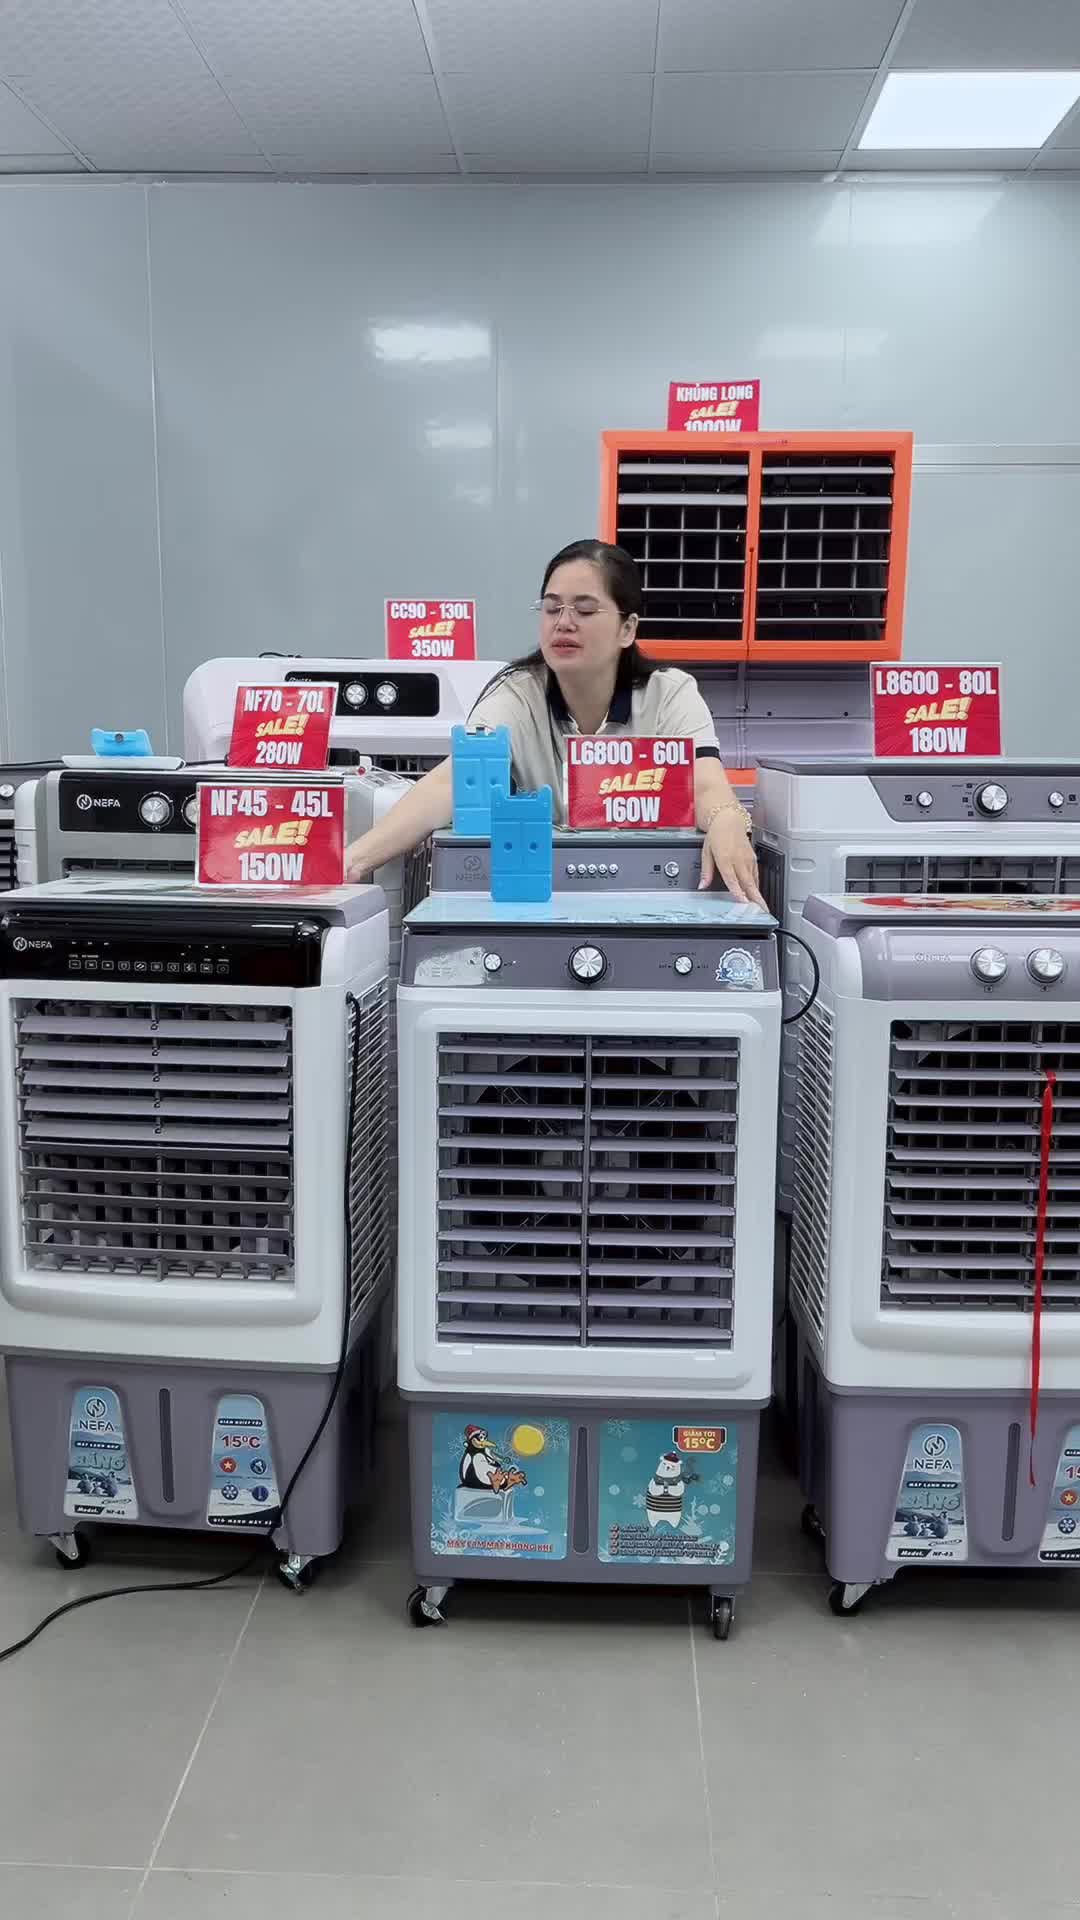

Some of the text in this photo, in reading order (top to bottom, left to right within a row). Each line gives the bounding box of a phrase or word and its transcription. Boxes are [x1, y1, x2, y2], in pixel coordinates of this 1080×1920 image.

[721, 384, 753, 400] LONG
[689, 401, 739, 420] SALE!
[391, 603, 426, 619] CC90
[439, 603, 471, 619] 130L
[408, 621, 455, 639] SALE!
[411, 640, 454, 657] 350W
[876, 670, 939, 695] L8600
[959, 670, 996, 695] 80L
[244, 689, 283, 712] NF70
[297, 691, 325, 713] 70L
[904, 697, 972, 725] SALE!
[255, 714, 310, 738] SALE!
[909, 727, 967, 753] 180W
[255, 741, 303, 765] 280W
[571, 741, 633, 765] L6800
[653, 741, 690, 765] 60L
[598, 768, 667, 795] SALE!
[93, 798, 121, 808] NEFA
[211, 790, 268, 816] NF45
[291, 791, 333, 817] 45L
[603, 797, 660, 823] 160W
[234, 820, 313, 849] SALE!
[238, 853, 304, 881] 150W
[28, 940, 53, 949] NEFA
[79, 1420, 115, 1432] NEFA
[914, 1460, 952, 1469] NEFA
